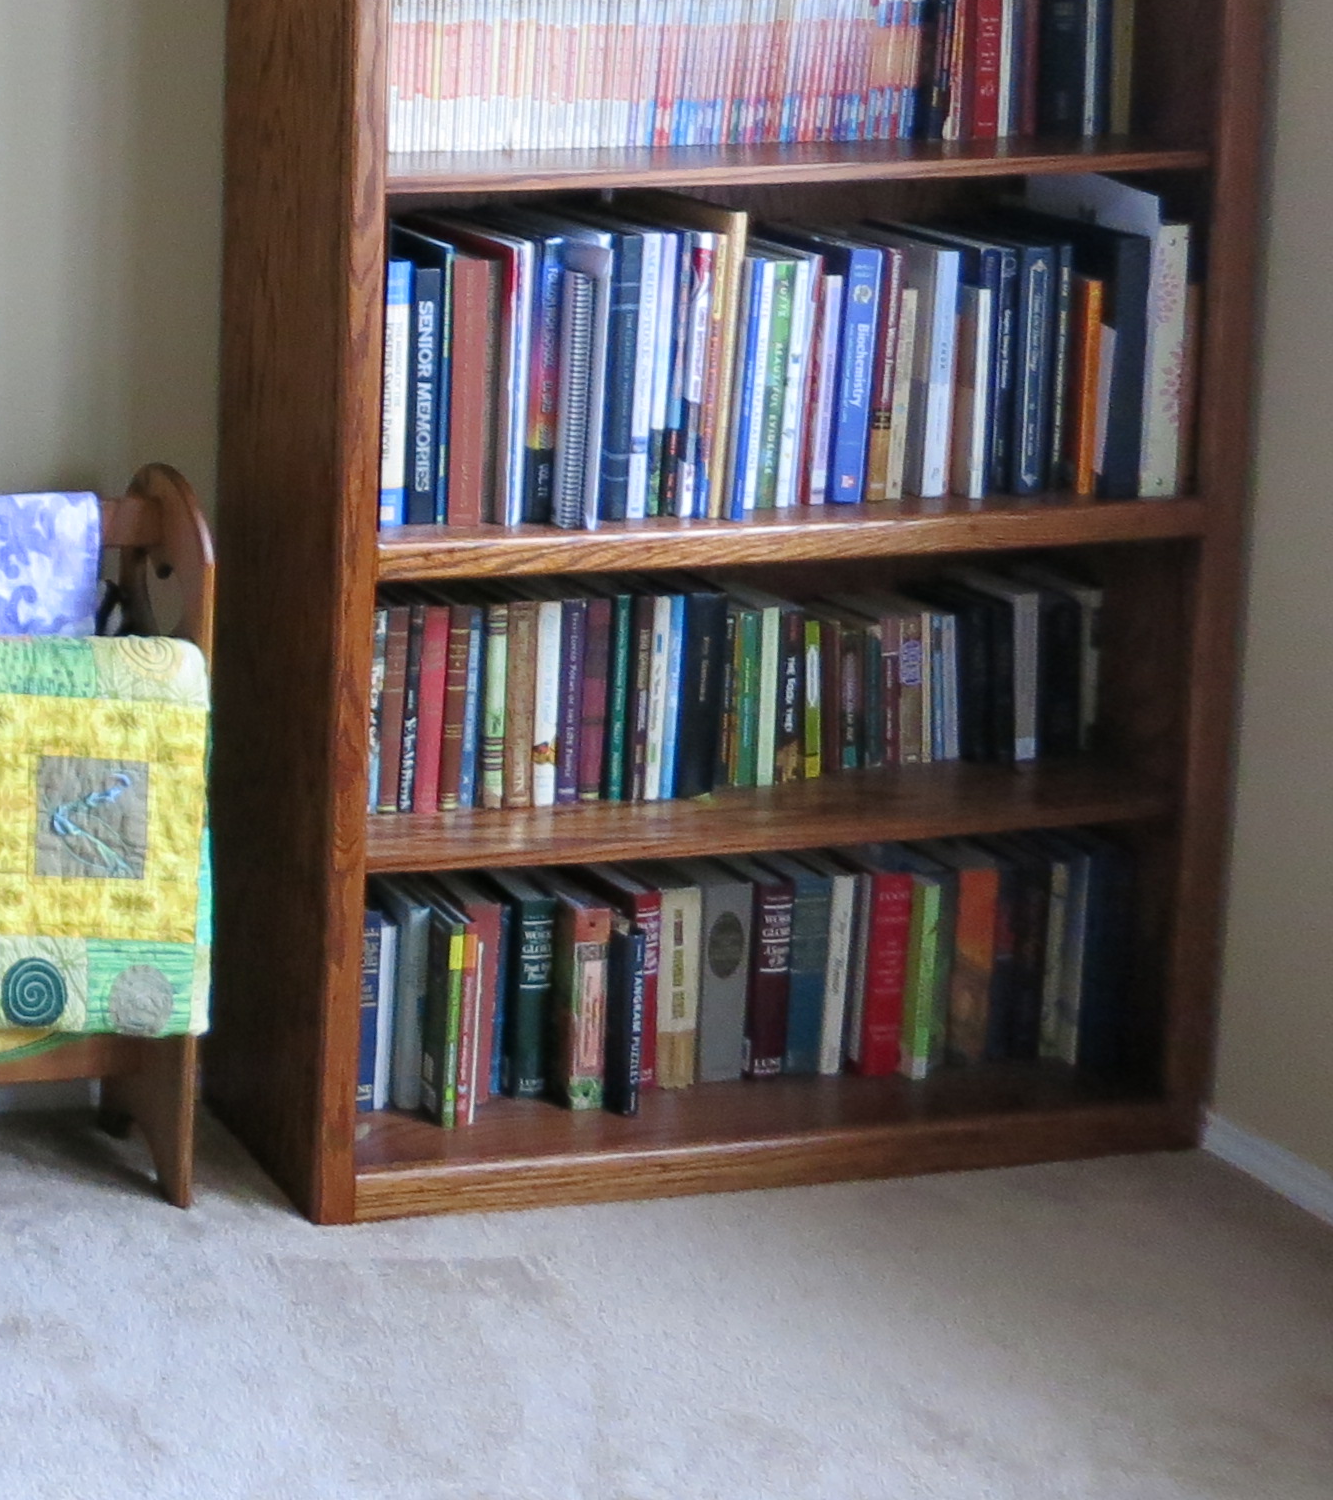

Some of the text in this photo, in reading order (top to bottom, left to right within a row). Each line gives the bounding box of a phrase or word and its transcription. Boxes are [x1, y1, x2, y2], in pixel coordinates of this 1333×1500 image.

[756, 338, 767, 378] VISUAL
[769, 342, 783, 408] BEAUTIFUL
[849, 323, 870, 409] Biochemistry
[415, 301, 433, 492] SENIOR MEMORIES
[748, 382, 763, 472] EXPLANATIONS
[764, 414, 777, 474] EVIDENCE
[785, 678, 796, 704] BOOK
[786, 656, 796, 675] THE
[629, 969, 643, 1085] TANGRAM PUZZLES
